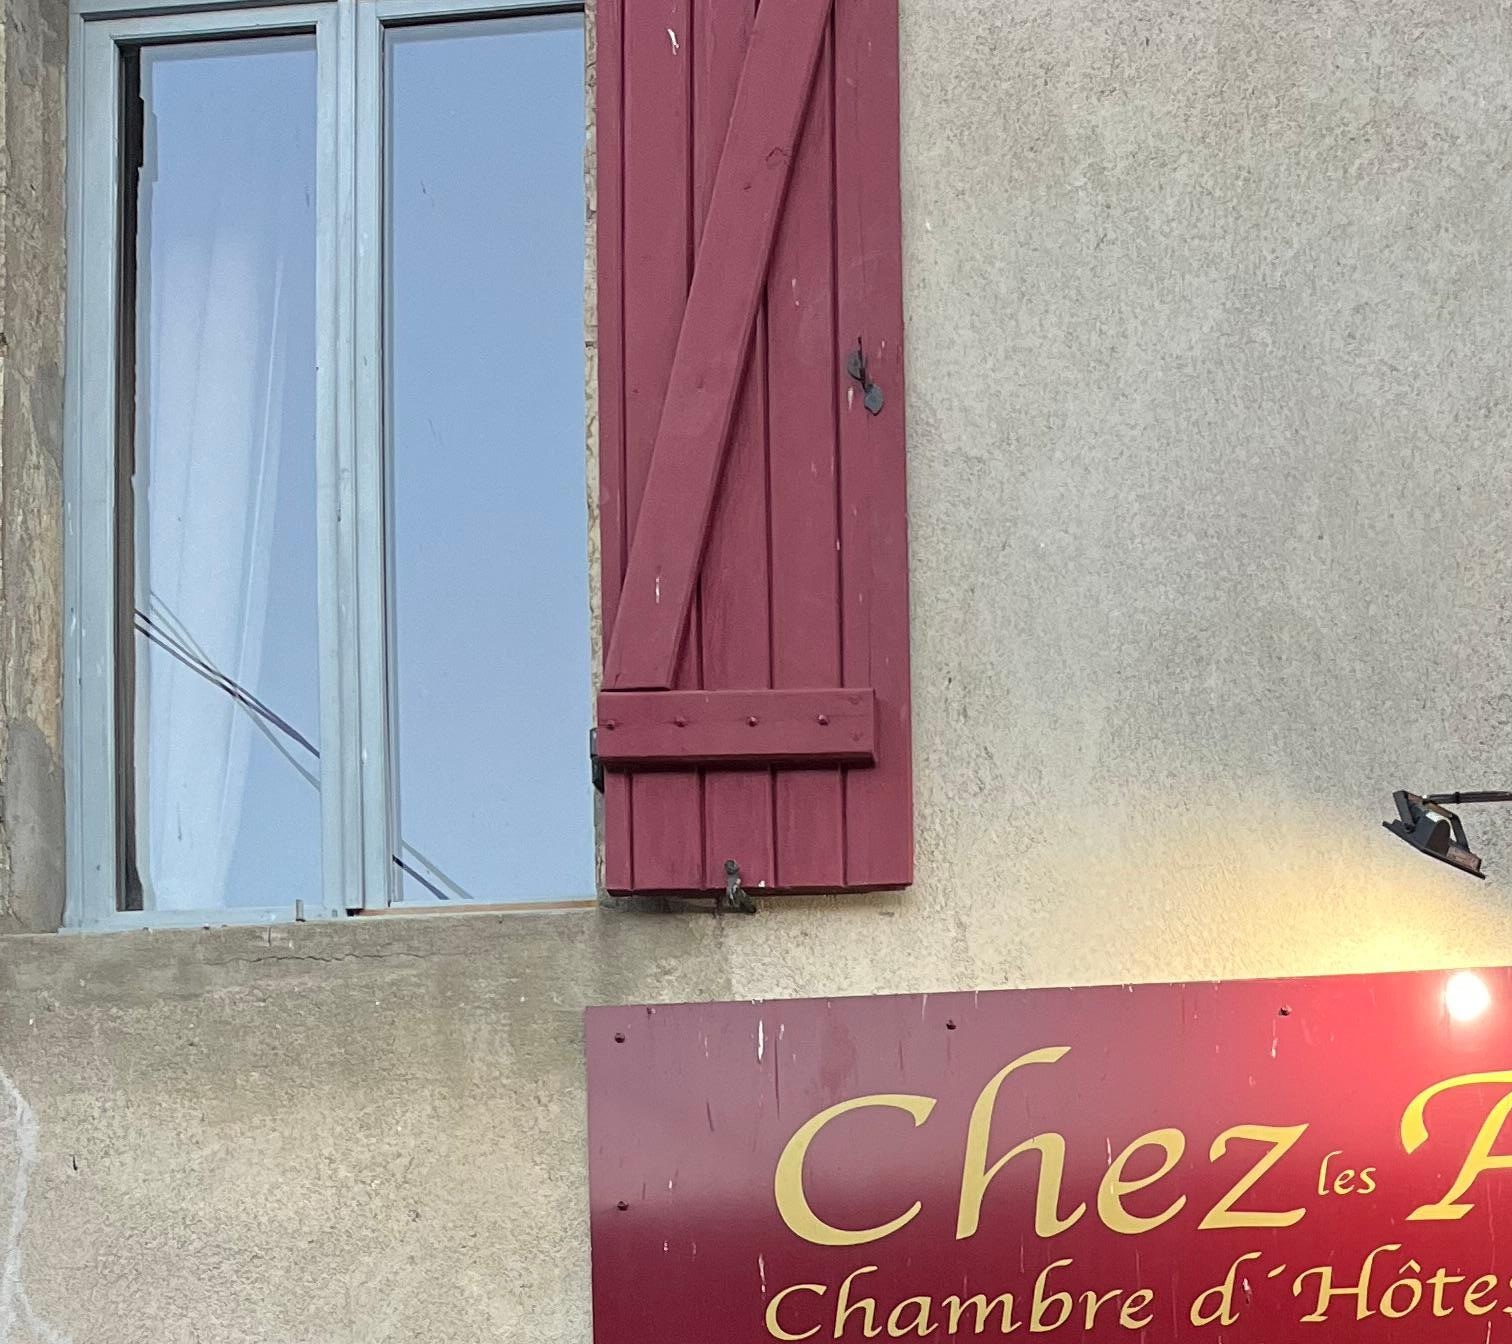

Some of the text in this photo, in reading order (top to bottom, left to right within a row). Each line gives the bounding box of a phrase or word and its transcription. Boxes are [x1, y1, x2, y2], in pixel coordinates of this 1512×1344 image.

[772, 1045, 1310, 1247] Chez
[1317, 1150, 1378, 1198] les
[764, 1255, 1156, 1342] Chambre
